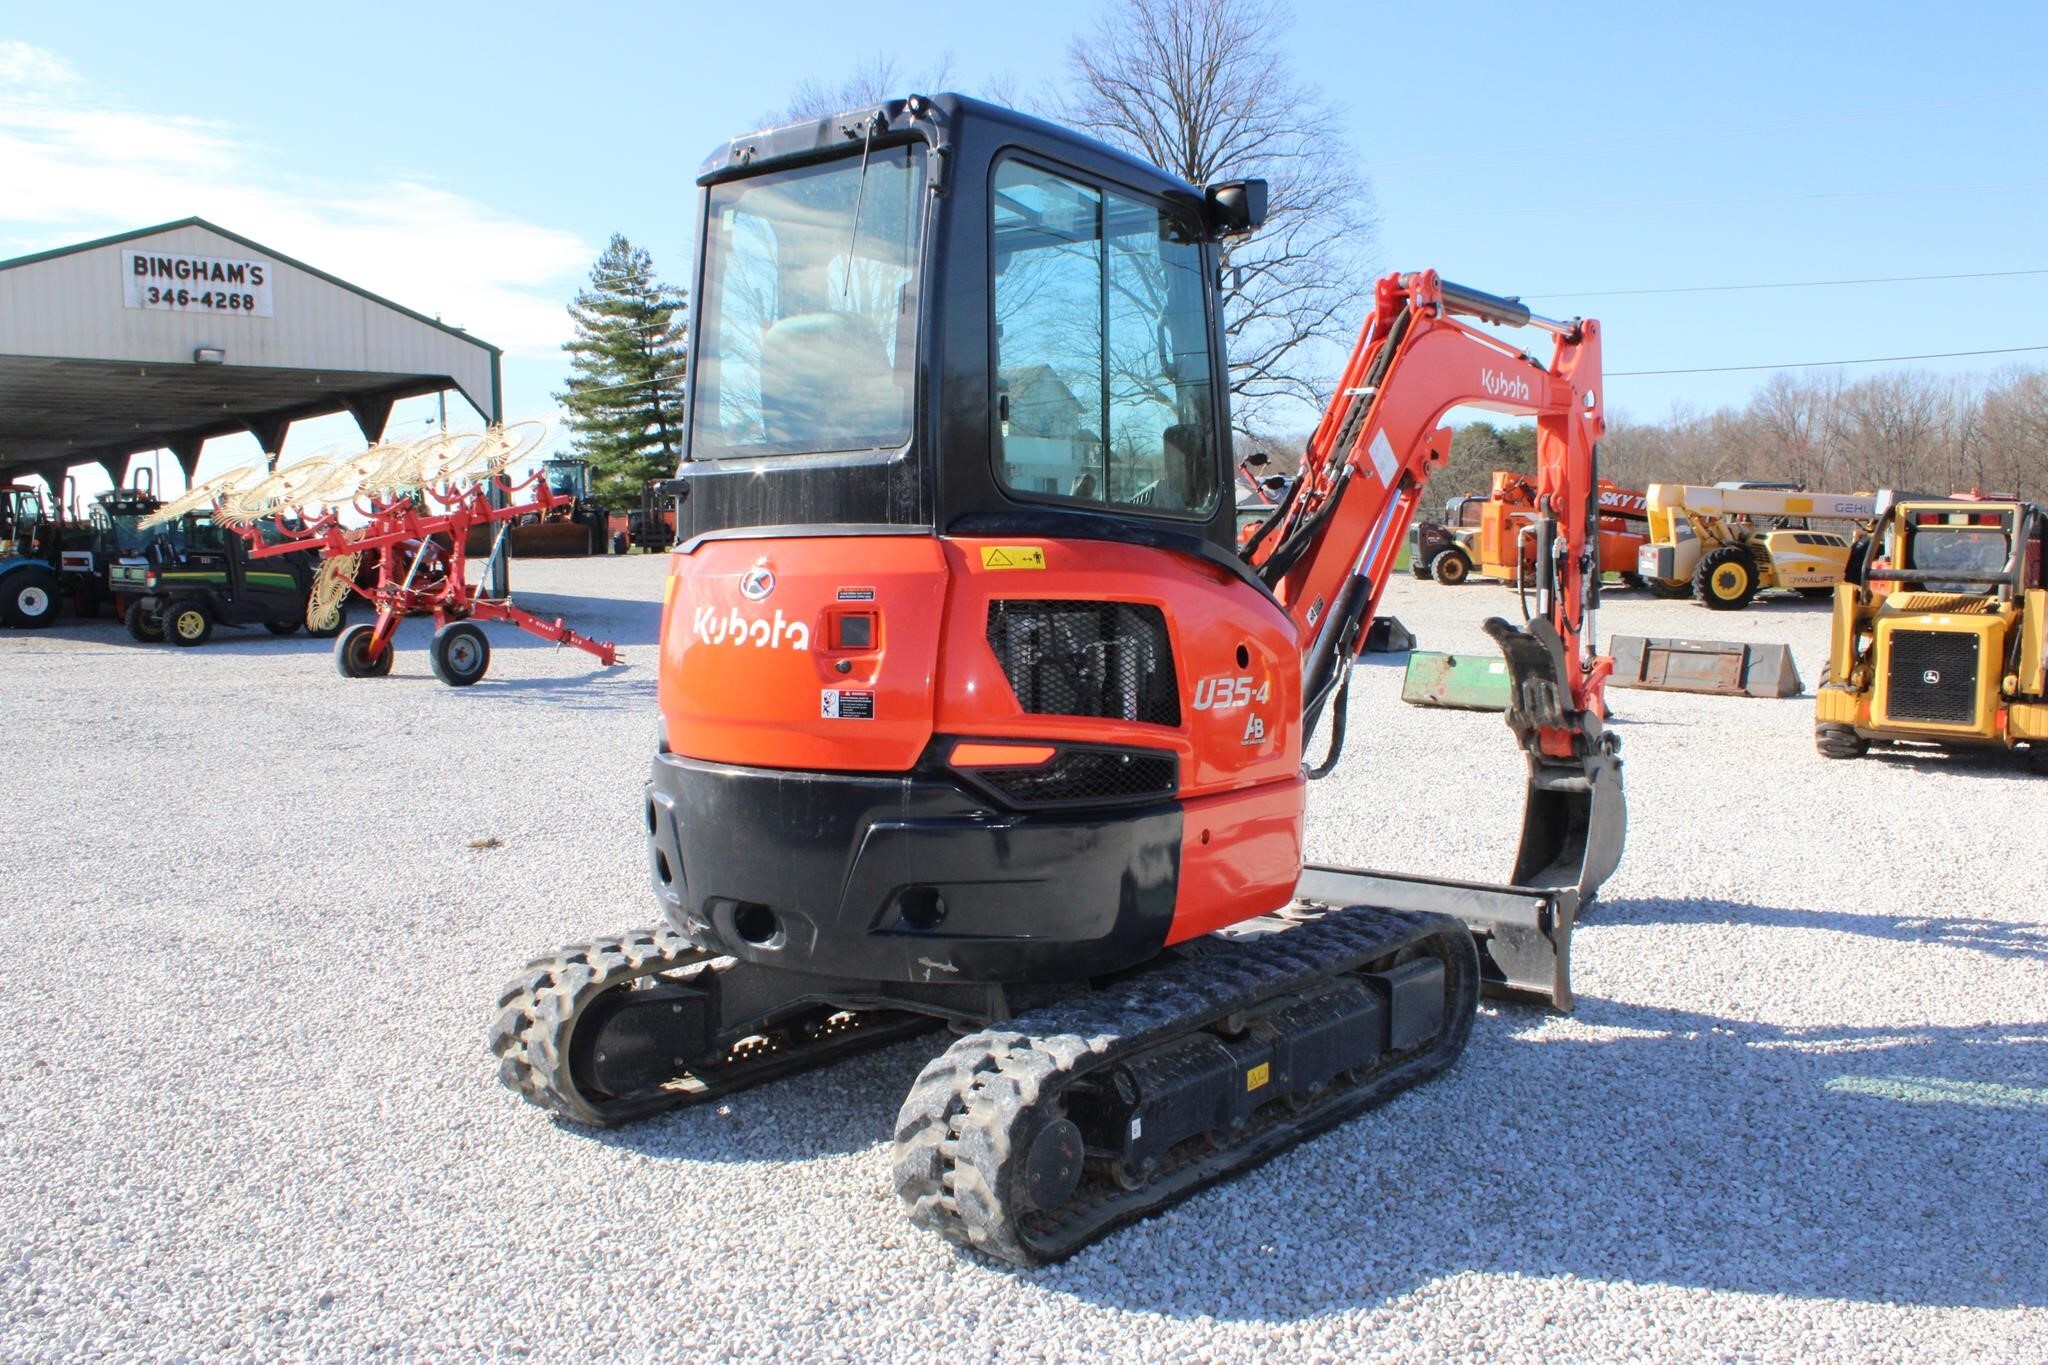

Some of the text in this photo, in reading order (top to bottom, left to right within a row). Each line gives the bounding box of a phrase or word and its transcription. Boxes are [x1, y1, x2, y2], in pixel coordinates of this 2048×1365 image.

[133, 255, 264, 286] BINGHAM'S
[148, 286, 255, 310] 346-4268
[1482, 368, 1528, 400] Kubota
[1599, 491, 1634, 507] SKY
[693, 606, 809, 650] Kubota
[1194, 677, 1270, 710] U35-4
